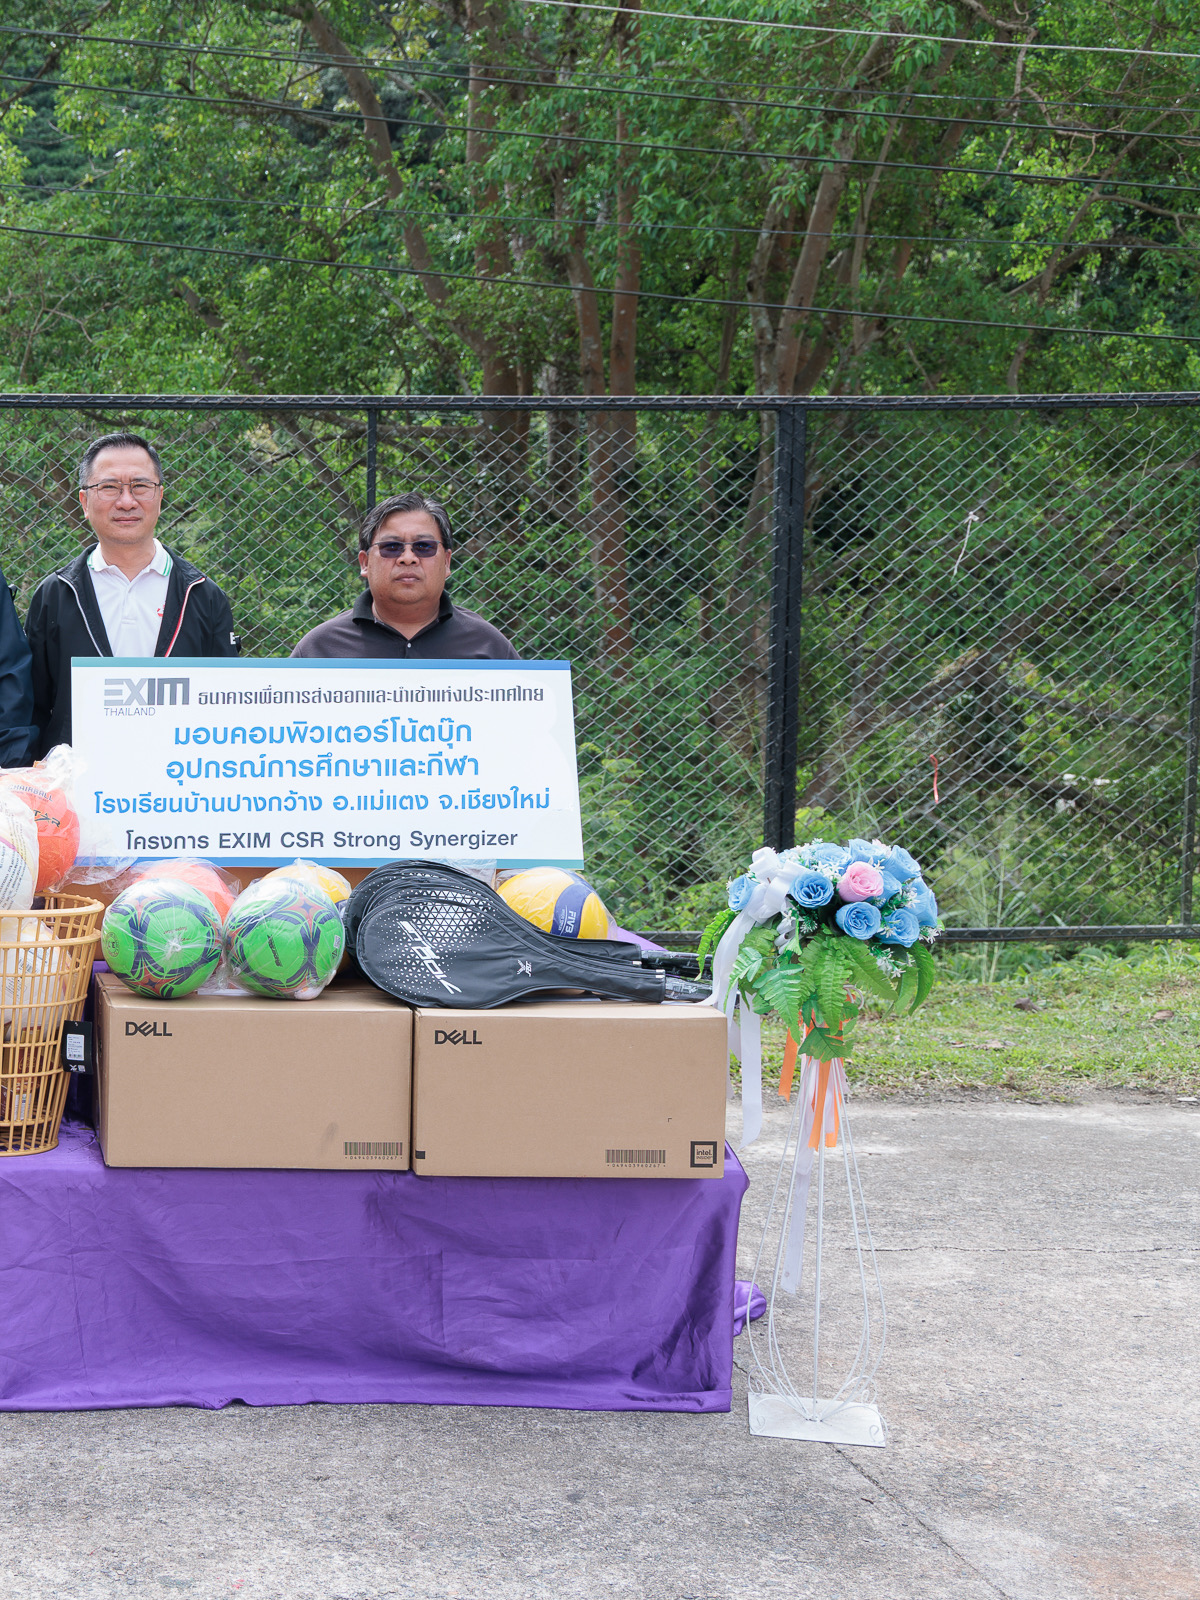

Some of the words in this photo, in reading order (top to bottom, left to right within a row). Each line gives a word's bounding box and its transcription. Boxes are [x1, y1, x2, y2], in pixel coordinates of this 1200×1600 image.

[104, 678, 190, 706] EXIM
[199, 685, 543, 705] ธนาคารเพื่อการส่งออกและนำเข้าแห่งประเทศไทย
[104, 707, 155, 716] THAILAND
[175, 717, 471, 749] มอบคอมพิวเตอร์โน้ตบุ๊ก
[166, 751, 478, 786] อุปกรณ์การศึกษาและกีฬา
[94, 790, 322, 813] โรงเรียนบ้านปางกว้าง
[333, 789, 429, 810] อ.แม่แตง
[438, 786, 549, 809] จ.เชียงใหม่
[126, 830, 209, 850] โครงการ
[219, 832, 270, 848] EXIM
[281, 832, 324, 848] CSR
[334, 831, 400, 850] Strong
[410, 830, 518, 850] Synergizer
[125, 1021, 172, 1036] DELL
[435, 1030, 482, 1045] DELL
